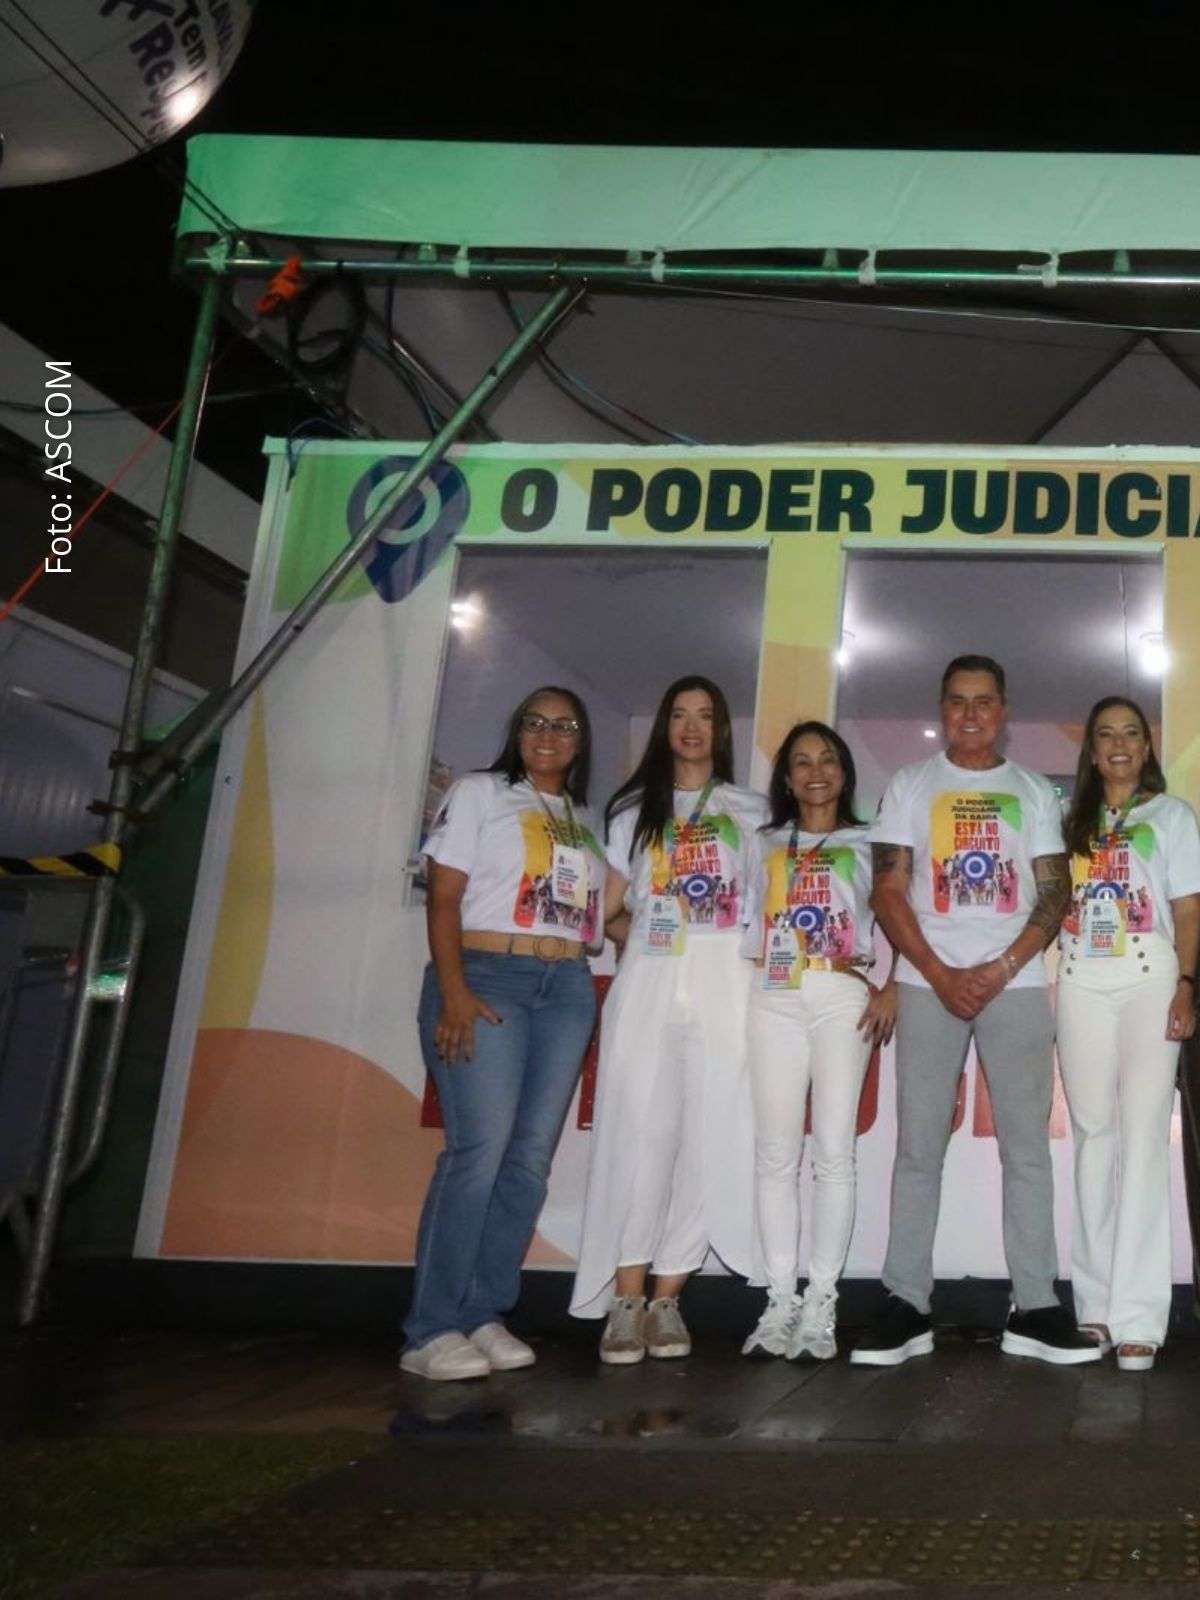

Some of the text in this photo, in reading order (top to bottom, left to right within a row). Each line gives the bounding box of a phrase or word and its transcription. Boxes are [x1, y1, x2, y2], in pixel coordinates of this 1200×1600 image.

[501, 467, 559, 533] O
[586, 467, 875, 533] PODER
[955, 821, 998, 836] ESTÁ NO
[954, 837, 1000, 850] CIRCUITO
